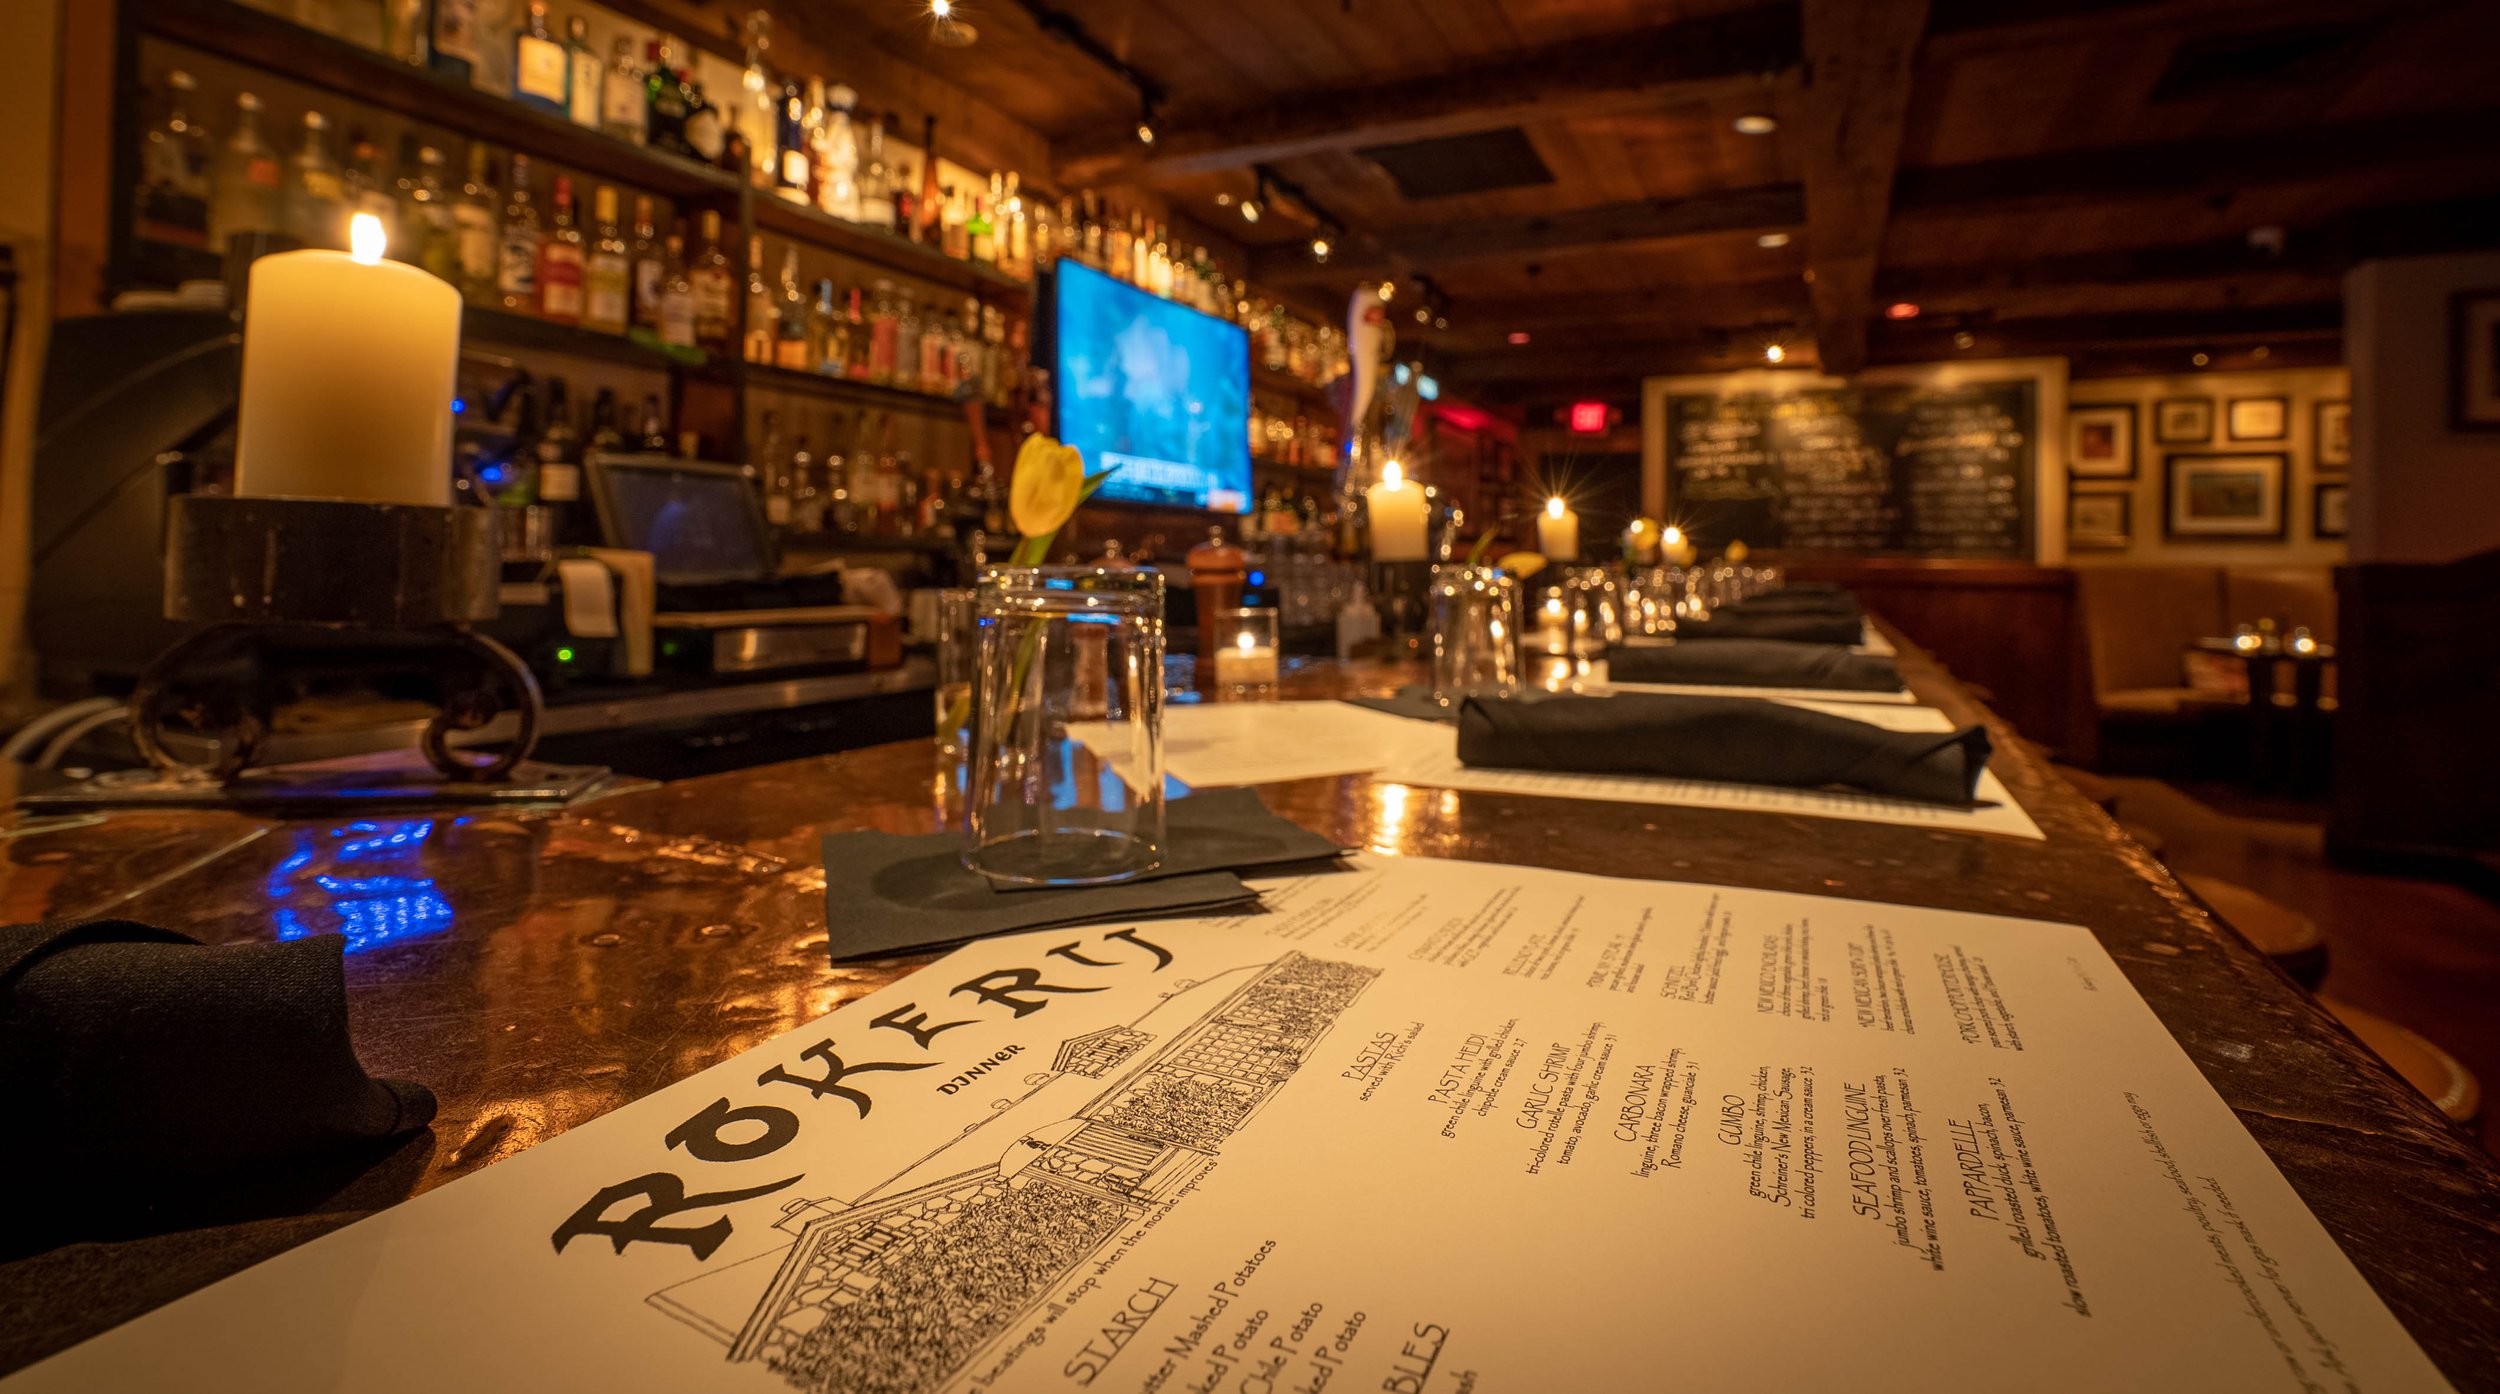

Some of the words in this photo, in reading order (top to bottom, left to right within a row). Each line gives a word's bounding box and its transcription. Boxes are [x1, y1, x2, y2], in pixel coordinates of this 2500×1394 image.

[1397, 1021, 1424, 1039] salad
[1341, 1032, 1398, 1081] PASTAS
[1384, 1040, 1412, 1061] Rich's
[1486, 1038, 1504, 1059] grilled
[1575, 1040, 1595, 1060] jumbo
[1600, 1043, 1613, 1061] sauce
[1661, 1048, 1686, 1068] shrimp,
[936, 1044, 1025, 1095] DINNER
[1378, 1062, 1395, 1076] with
[1428, 1065, 1471, 1104] PASTA
[1455, 1033, 1488, 1062] HEIDI
[1478, 1058, 1494, 1071] with
[1564, 1072, 1579, 1085] with
[1566, 1057, 1586, 1072] four
[1593, 1061, 1606, 1080] cream
[1750, 1066, 1771, 1091] chicken,
[1800, 1066, 1815, 1076] 32
[1893, 1068, 1908, 1077] 32
[1359, 1075, 1383, 1101] served
[1457, 1072, 1486, 1098] linguine
[1472, 1088, 1499, 1117] chipotle
[1494, 1068, 1510, 1087] cream
[1505, 1049, 1520, 1067] sauce
[1516, 1083, 1553, 1129] GARLIC
[1538, 1042, 1571, 1083] SHRIMP
[1581, 1081, 1600, 1101] garlic
[1659, 1067, 1682, 1097] wrapped
[1677, 1072, 1697, 1105] guanciale
[1773, 1067, 1796, 1100] Sausage,
[1804, 1077, 1813, 1097] sauce
[1873, 1075, 1894, 1096] pasta,
[1898, 1079, 1921, 1113] parmesan
[1988, 1077, 2005, 1087] 32
[1449, 1098, 1470, 1115] chile
[1559, 1087, 1575, 1108] pasta
[1614, 1066, 1656, 1142] CARBONARA
[1646, 1098, 1667, 1121] bacon
[1748, 1093, 1775, 1117] shrimp,
[1804, 1098, 1813, 1119] cream
[1844, 1082, 1871, 1141] LINGUINE
[1870, 1095, 1889, 1114] fresh
[1996, 1089, 2025, 1124] parmesan
[1441, 1115, 1460, 1139] green
[1546, 1108, 1565, 1132] rotelle
[1571, 1101, 1594, 1134] avocado,
[1668, 1105, 1693, 1133] cheese,
[1718, 1095, 1745, 1145] GUMBO
[1771, 1099, 1792, 1132] Mexican
[1880, 1114, 1892, 1131] over
[1896, 1113, 1927, 1143] spinach,
[1975, 1103, 1994, 1127] bacon,
[1641, 1122, 1662, 1143] three
[1744, 1119, 1772, 1149] linguine,
[1771, 1133, 1791, 1153] New
[1799, 1126, 1813, 1134] in
[2009, 1124, 2026, 1148] sauce,
[1526, 1130, 1554, 1174] tri-colored
[1556, 1136, 1582, 1164] tomato,
[1661, 1134, 1684, 1169] Romano
[1804, 1135, 1823, 1173] peppers,
[1876, 1132, 1903, 1165] scallops
[1977, 1129, 2013, 1161] spinach,
[2015, 1149, 2033, 1168] wine
[1630, 1145, 1660, 1178] linguine,
[1743, 1150, 1762, 1169] chile
[1878, 1164, 1900, 1183] and
[1910, 1145, 1927, 1186] tomatoes,
[1948, 1118, 1999, 1221] PAPPARDELLE
[1749, 1171, 1768, 1199] green
[1766, 1154, 1791, 1207] Schreiner's
[1795, 1170, 1815, 1207] colored
[1848, 1140, 1881, 1220] SEAFOOD
[1987, 1163, 2013, 1186] duck,
[2019, 1169, 2042, 1192] white
[1799, 1206, 1815, 1219] tri
[1883, 1184, 1911, 1215] shrimp
[1918, 1188, 1934, 1218] sauce,
[1994, 1185, 2026, 1225] roasted
[1920, 1219, 1938, 1241] wine
[2034, 1195, 2062, 1243] tomatoes,
[1886, 1216, 1924, 1252] jumbo
[2005, 1223, 2047, 1261] grilled
[1043, 1302, 1068, 1324] will
[1065, 1277, 1101, 1305] stop
[1094, 1248, 1127, 1275] when
[1121, 1230, 1146, 1247] the
[1143, 1199, 1179, 1229] morale
[1919, 1243, 1944, 1271] white
[2040, 1241, 2079, 1289] roasted
[1164, 1295, 1229, 1360] Mashed
[1214, 1240, 1276, 1297] Potatoes
[2063, 1289, 2092, 1318] slow
[1063, 1277, 1179, 1388] STARCH
[1211, 1310, 1269, 1363] Potato
[1269, 1302, 1323, 1355] Potato
[1314, 1311, 1366, 1365] Potato
